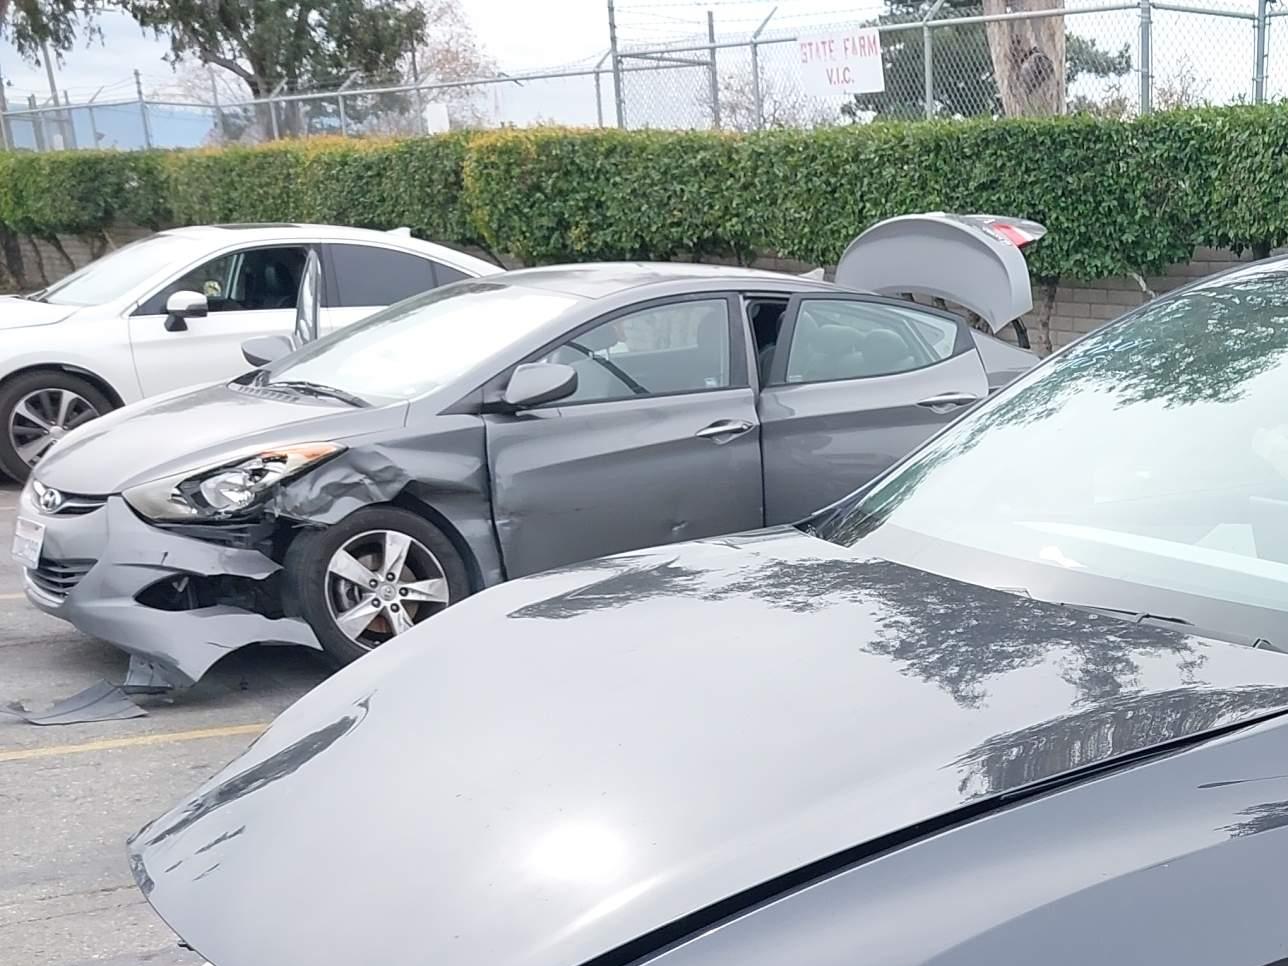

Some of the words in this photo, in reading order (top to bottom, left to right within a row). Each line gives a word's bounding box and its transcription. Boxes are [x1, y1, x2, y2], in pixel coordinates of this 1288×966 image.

[800, 39, 836, 63] STATE
[843, 34, 878, 59] FARM
[825, 66, 855, 85] V.I.C.
